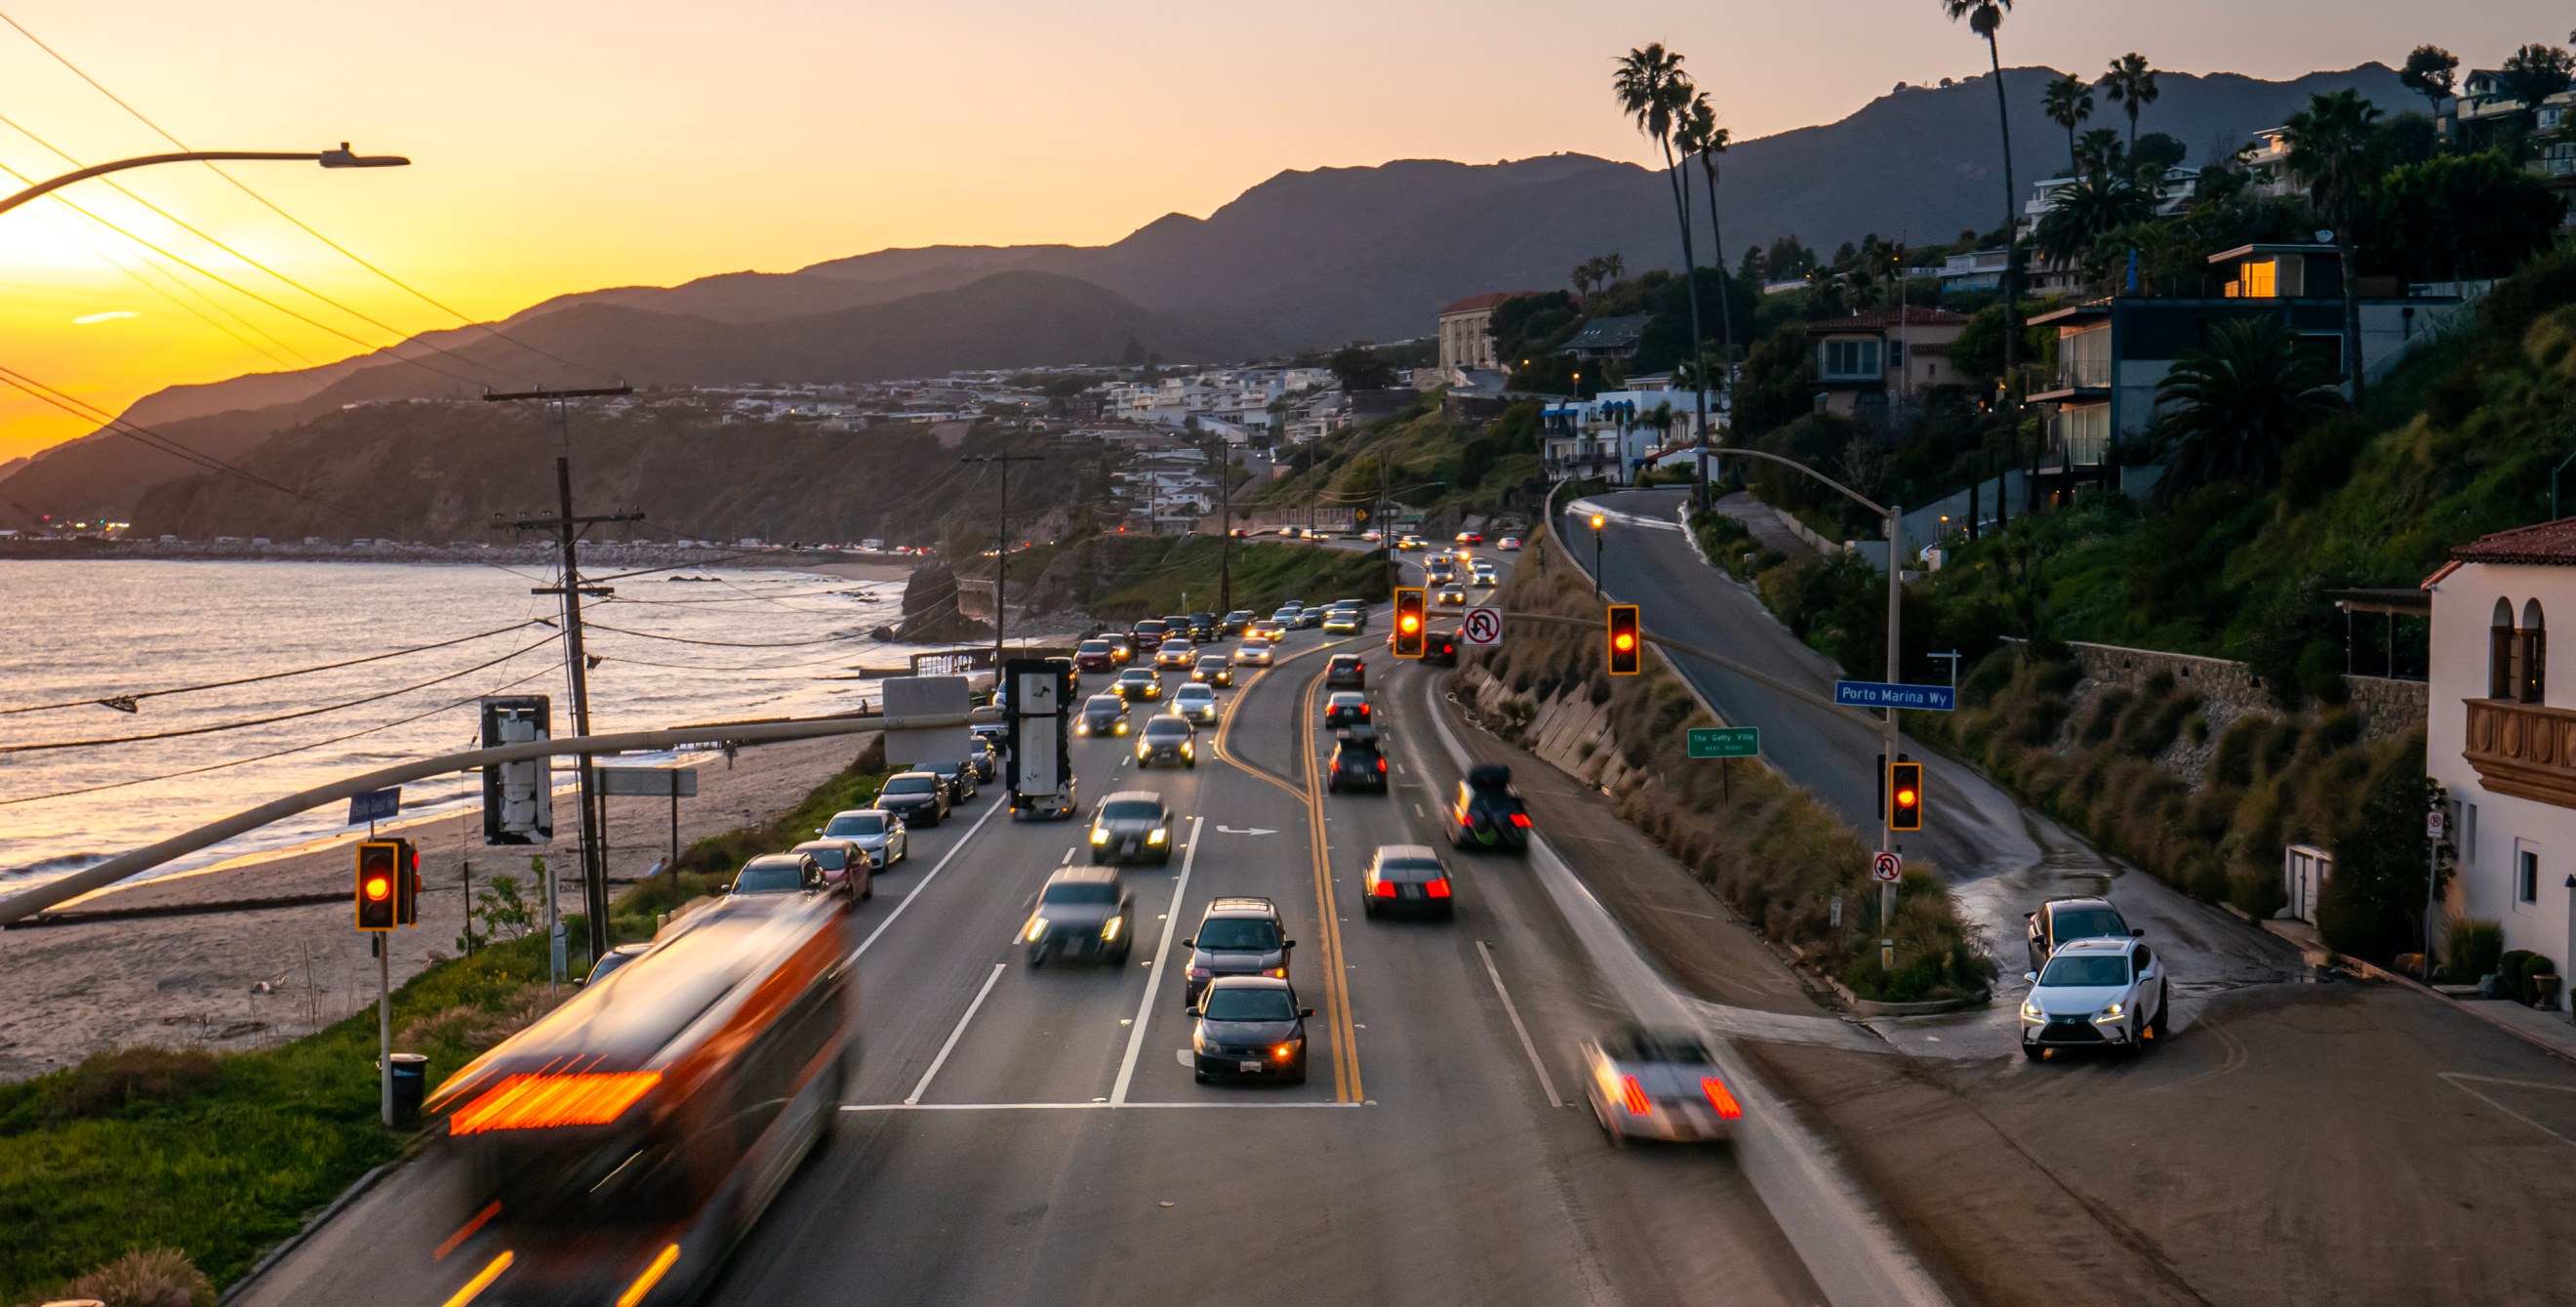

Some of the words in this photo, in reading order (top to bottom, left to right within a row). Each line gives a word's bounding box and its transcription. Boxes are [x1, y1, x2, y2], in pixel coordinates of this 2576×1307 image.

[1842, 687, 1876, 701] Porto
[1881, 689, 1923, 703] Marina
[1929, 692, 1947, 707] Wy
